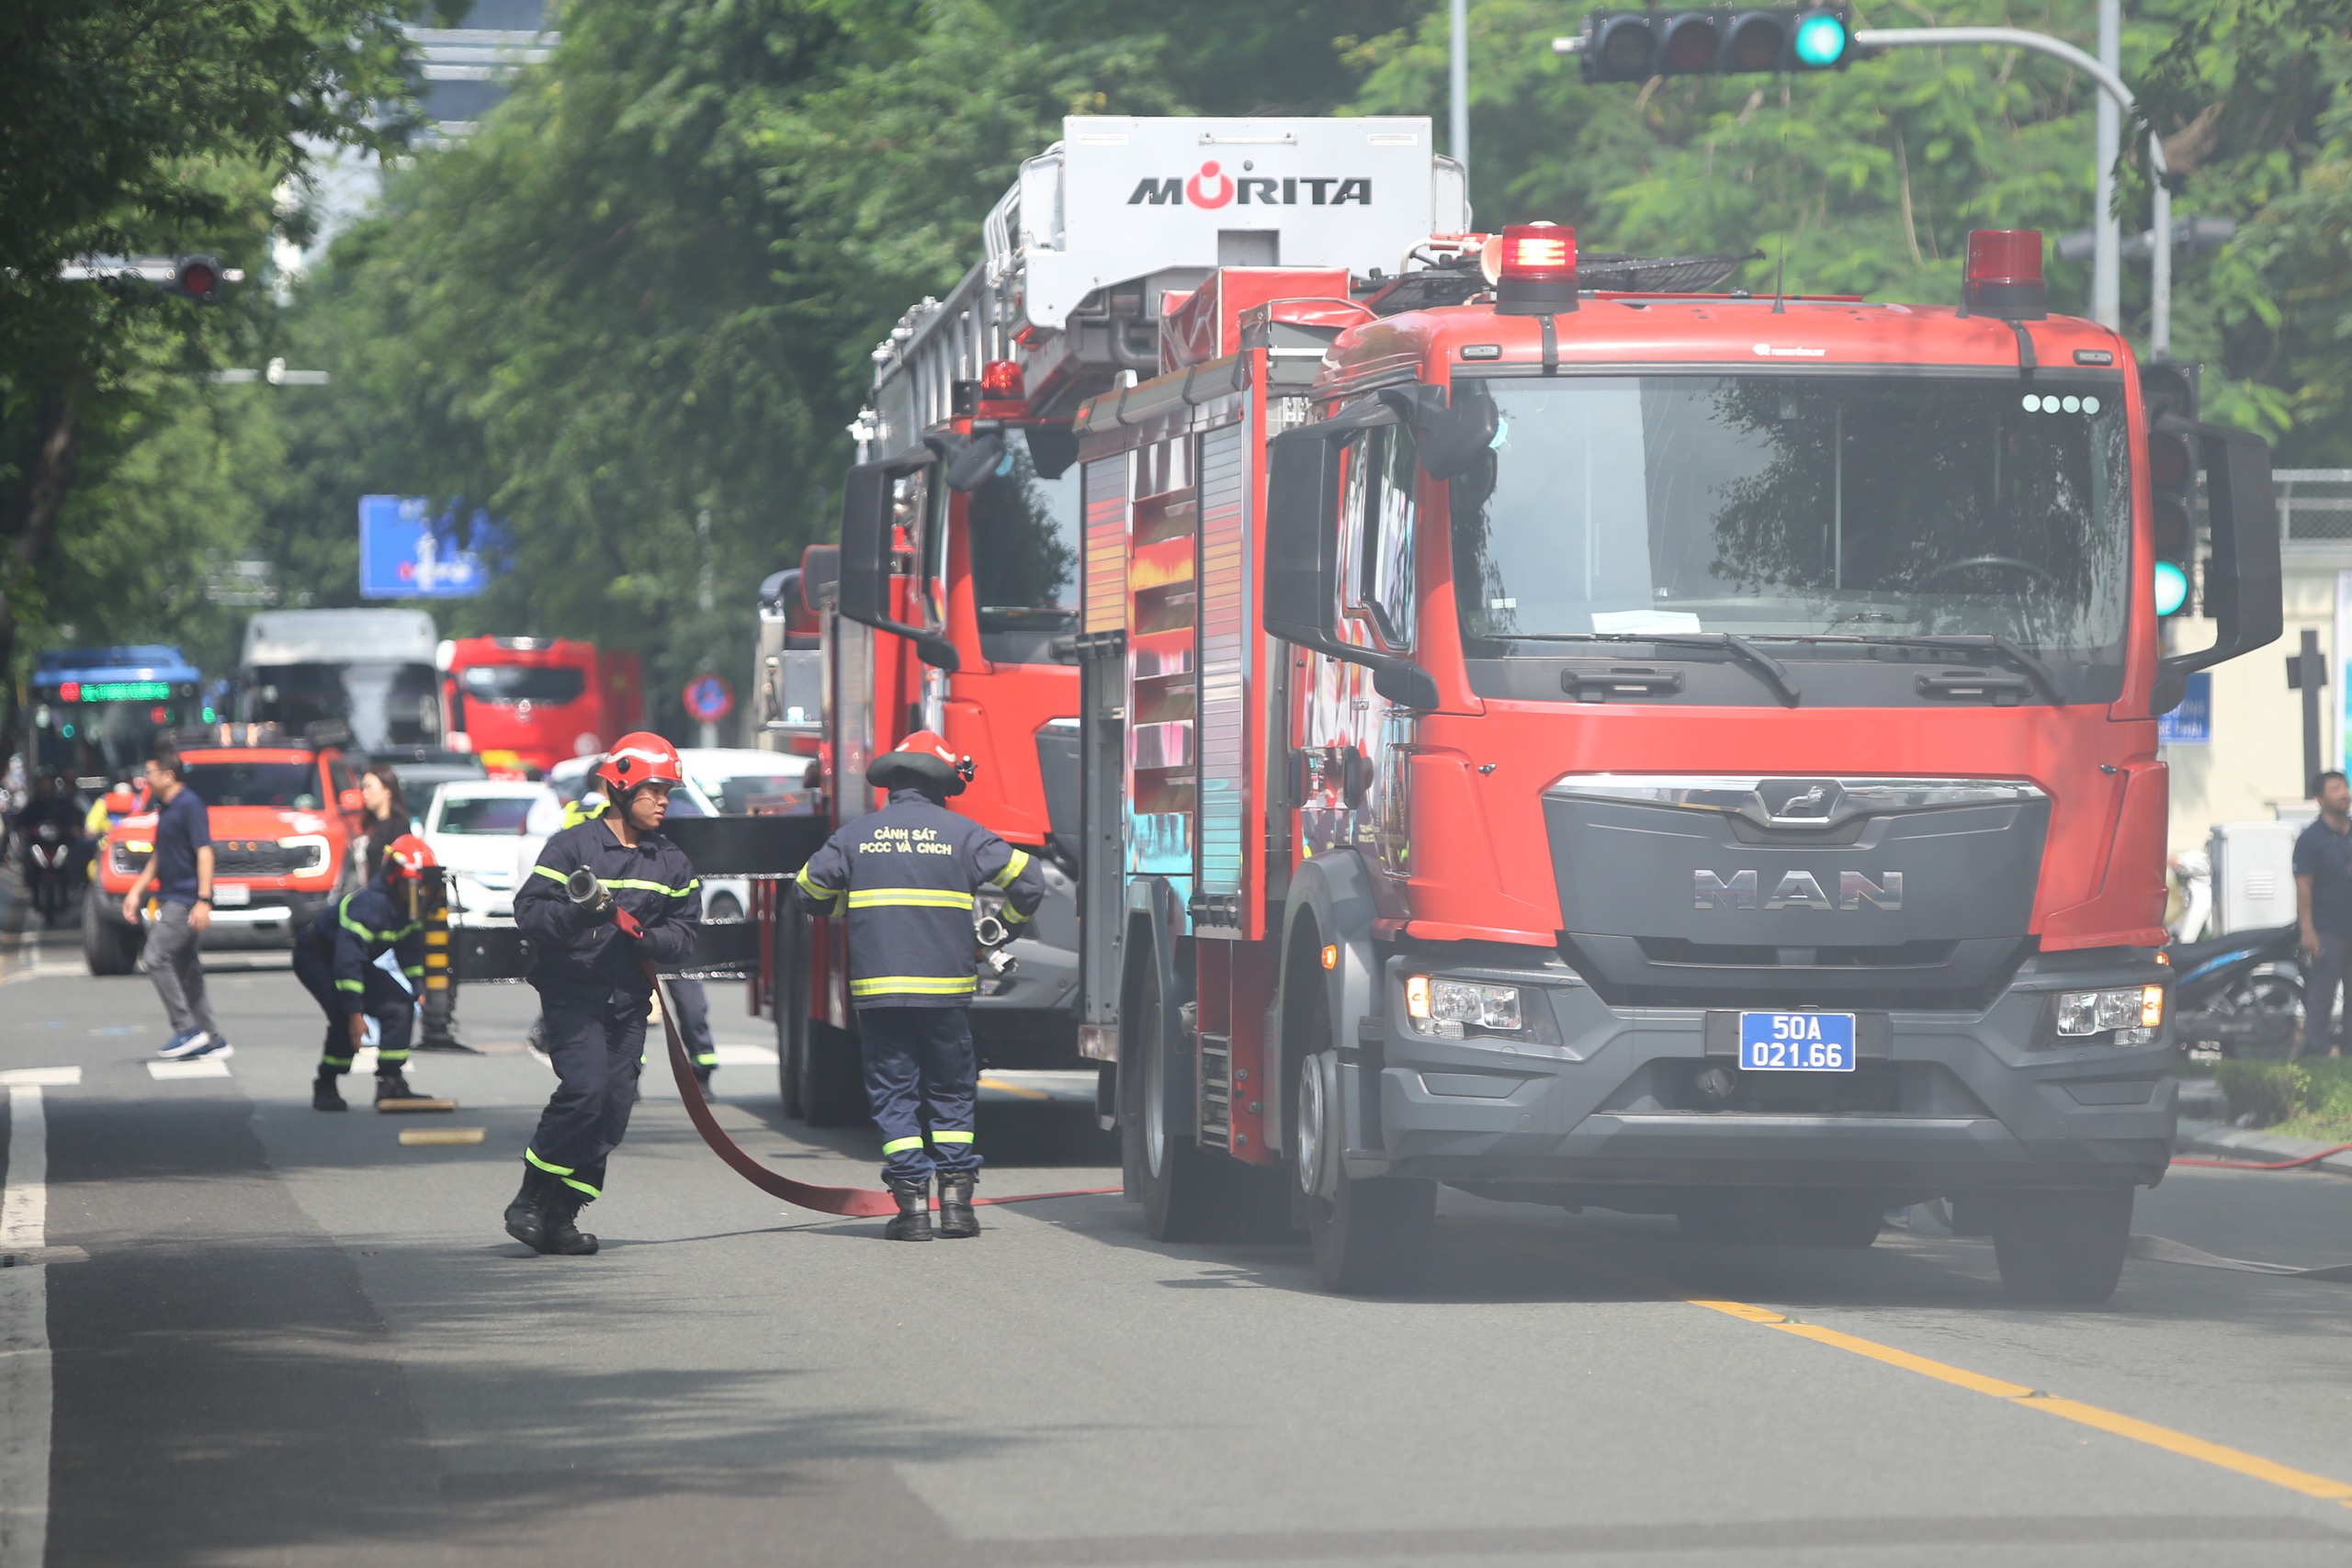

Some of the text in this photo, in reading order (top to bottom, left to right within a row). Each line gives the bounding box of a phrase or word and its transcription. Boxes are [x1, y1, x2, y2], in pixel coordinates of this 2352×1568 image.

[1126, 160, 1372, 209] MORITA
[874, 826, 937, 840] CẢNH SÁT
[859, 840, 952, 855] PCCC VÀ CNCH
[1694, 869, 1903, 911] MAN
[1772, 1015, 1822, 1040] 50A
[1753, 1042, 1842, 1067] 021.66
